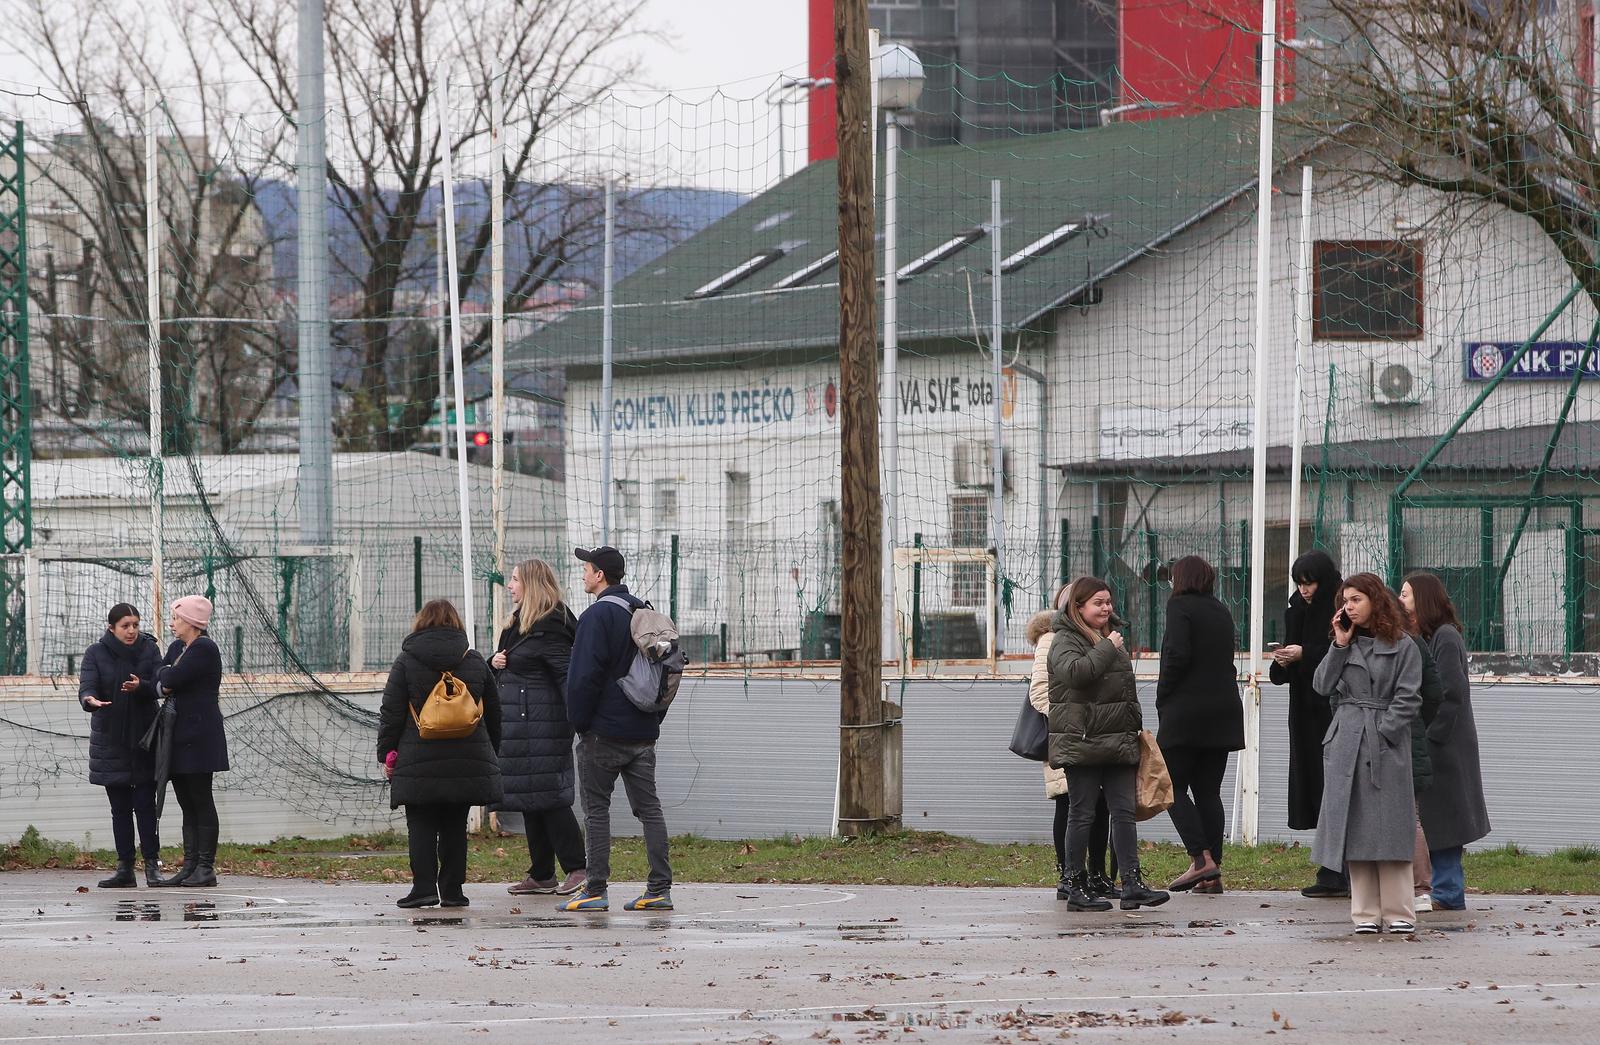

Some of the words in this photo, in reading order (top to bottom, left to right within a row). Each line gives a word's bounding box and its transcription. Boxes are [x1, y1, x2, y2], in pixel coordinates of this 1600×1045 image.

[1512, 349, 1552, 373] NK
[1559, 349, 1600, 373] PR
[590, 393, 681, 433] NGOMETNI
[686, 391, 727, 427] KLUB
[731, 377, 795, 425] PREČKO
[927, 376, 961, 414] SVE
